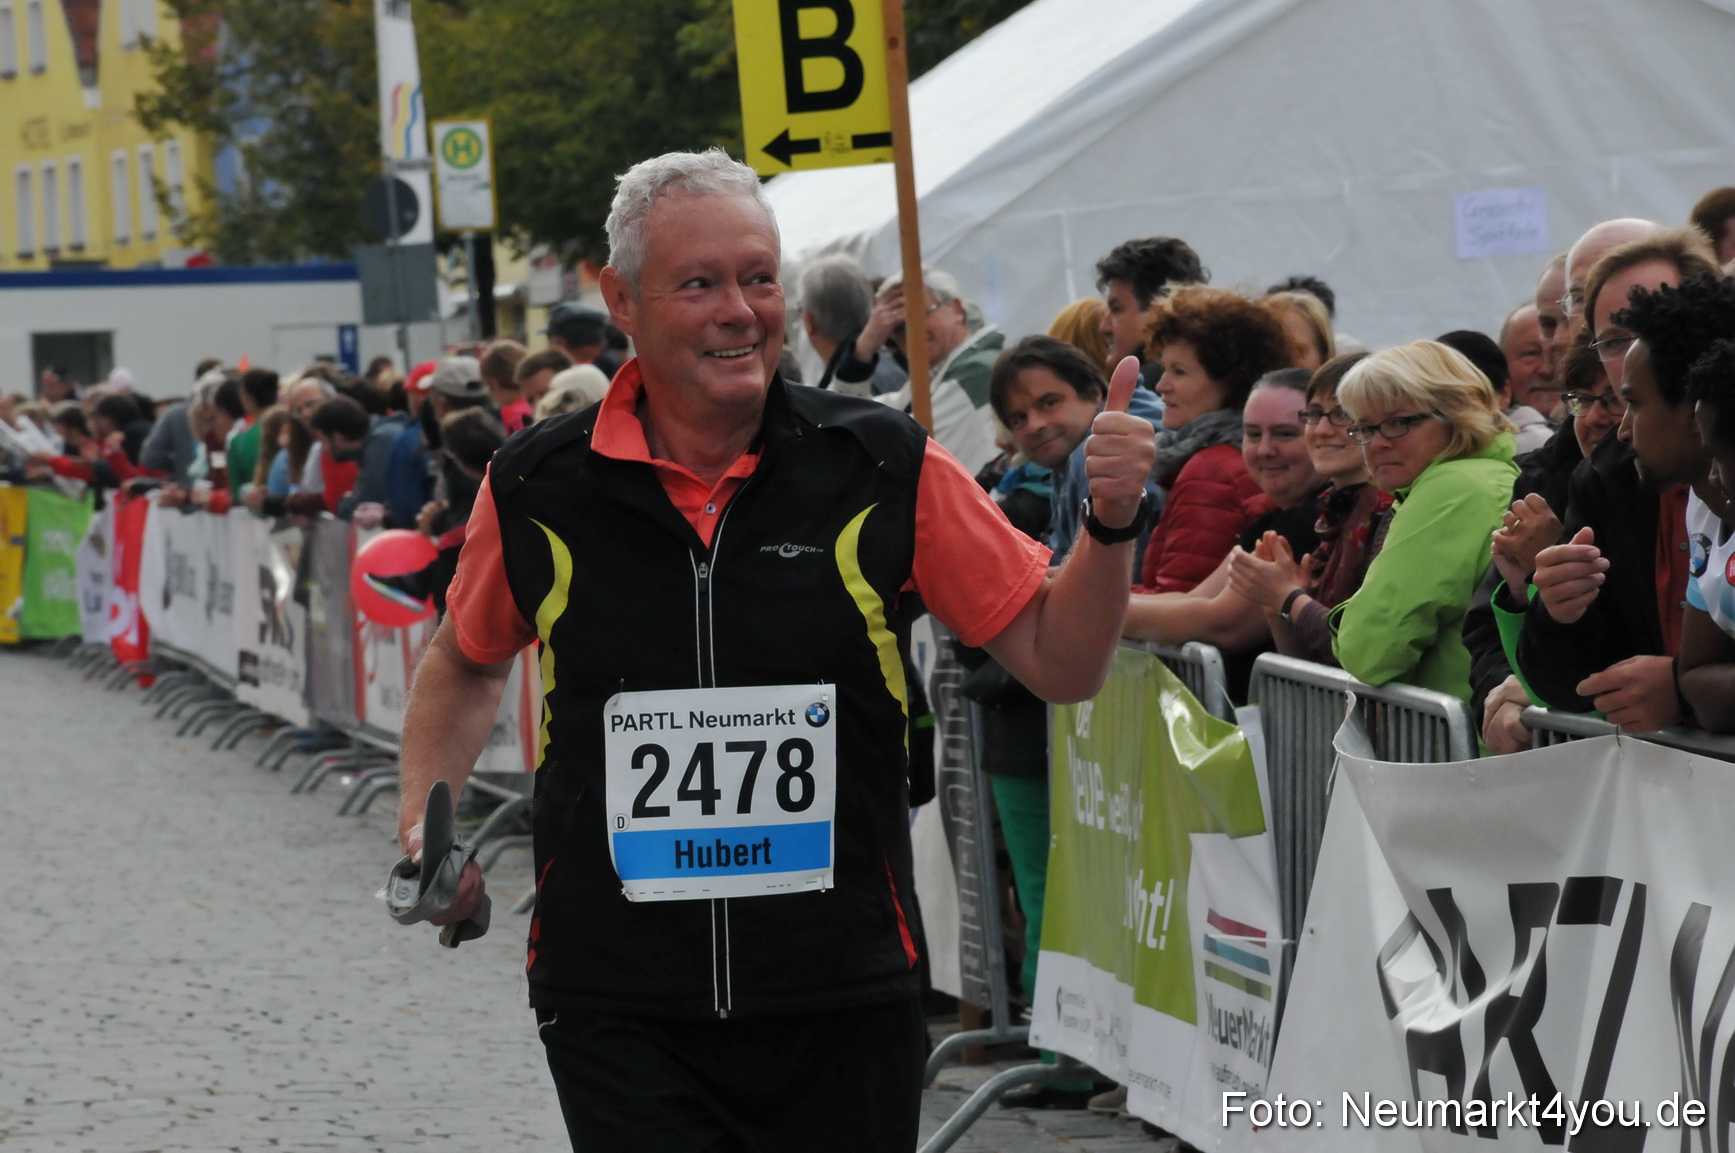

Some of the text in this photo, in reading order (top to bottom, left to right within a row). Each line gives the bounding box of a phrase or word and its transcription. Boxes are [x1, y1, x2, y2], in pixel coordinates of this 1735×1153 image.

[778, 0, 865, 115] B
[611, 708, 796, 732] PARTL Neumarkt
[631, 737, 816, 819] 2478
[617, 816, 625, 829] D
[674, 836, 772, 869] Hubert
